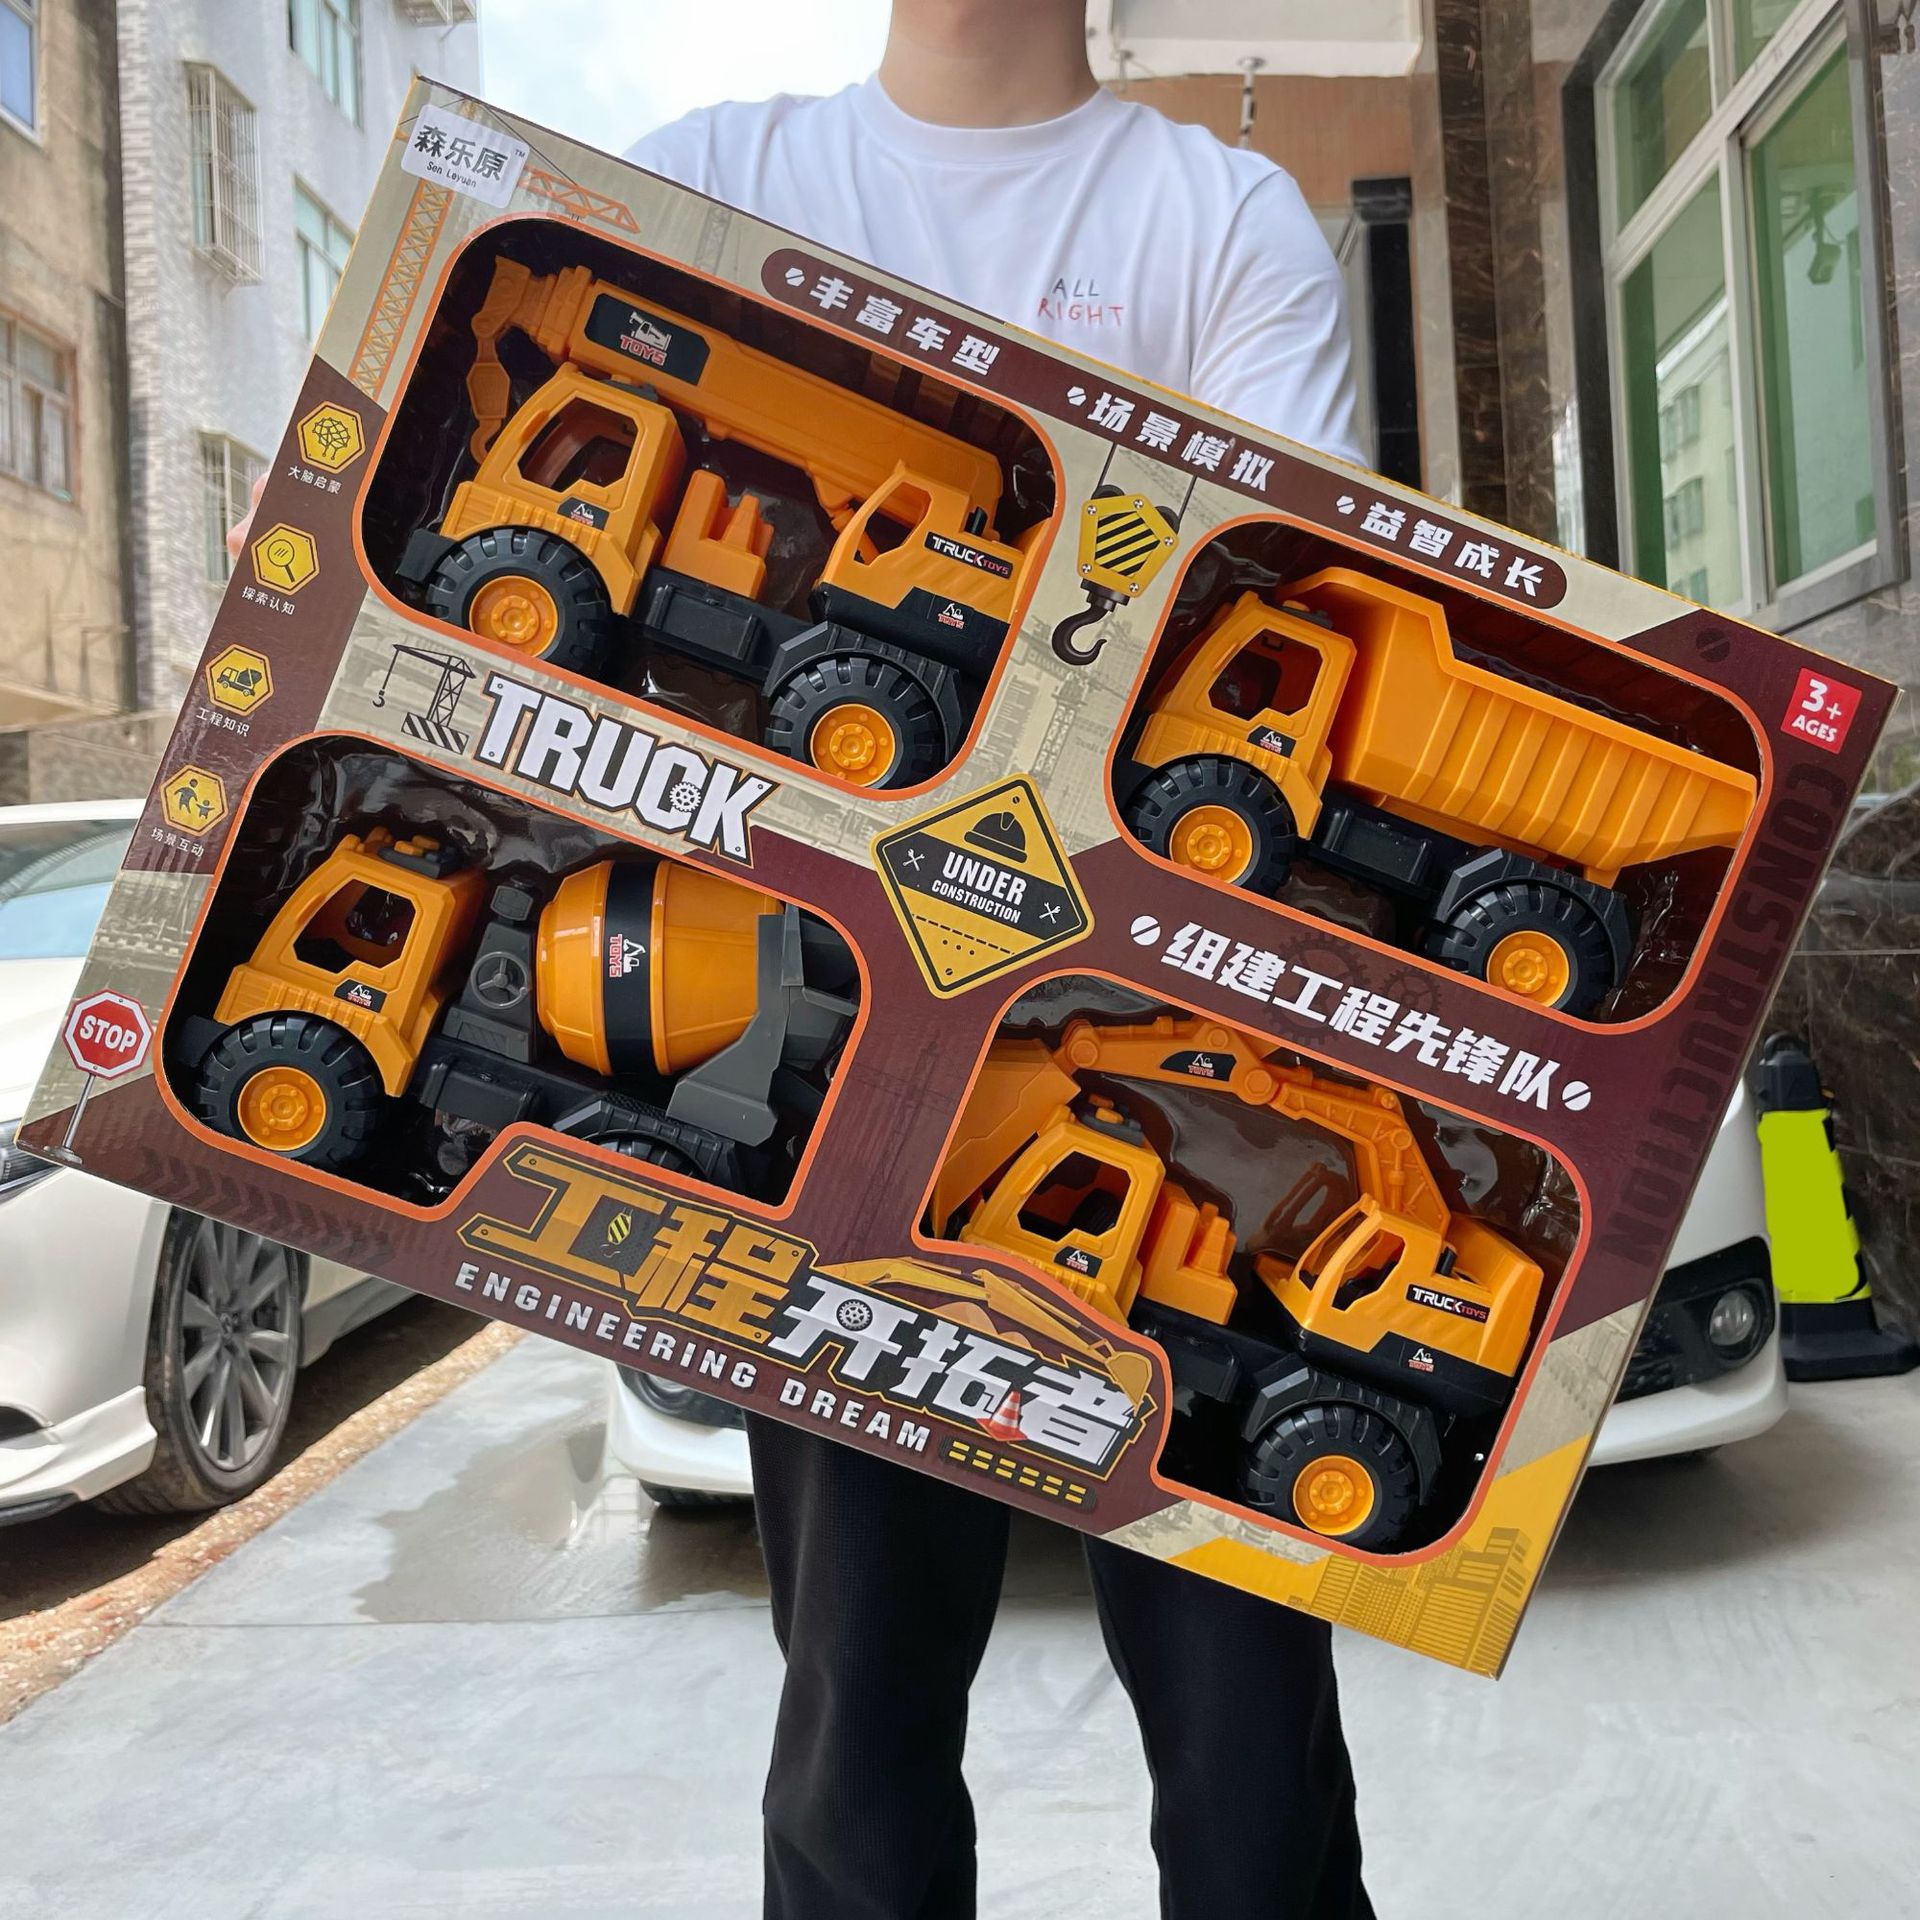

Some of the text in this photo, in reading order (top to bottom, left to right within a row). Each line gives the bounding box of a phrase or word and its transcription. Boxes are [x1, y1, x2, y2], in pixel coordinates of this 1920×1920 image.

[415, 125, 509, 181] 森乐原
[426, 161, 443, 175] Sen
[1052, 278, 1101, 299] ALL
[809, 275, 1001, 376] 丰富车型
[1037, 299, 1125, 328] RIGHT
[620, 334, 667, 366] TOYS
[1086, 390, 1277, 492] 场景模拟
[287, 465, 341, 495] 大脑启蒙
[1360, 502, 1545, 597] 益智成长
[241, 585, 296, 616] 探索认知
[1801, 678, 1842, 720] 3+
[195, 708, 251, 737] 工程知识
[1791, 714, 1838, 742] AGES
[477, 672, 777, 863] TRUCK
[151, 827, 204, 858] 场景互动
[942, 851, 1027, 905] UNDER
[931, 879, 1022, 924] CONSTRUCTION
[609, 933, 623, 977] TOYS
[79, 1015, 137, 1053] STOP
[1160, 921, 1561, 1111] 组建工程先锋队
[454, 1261, 931, 1453] ENGINEERING DREAM
